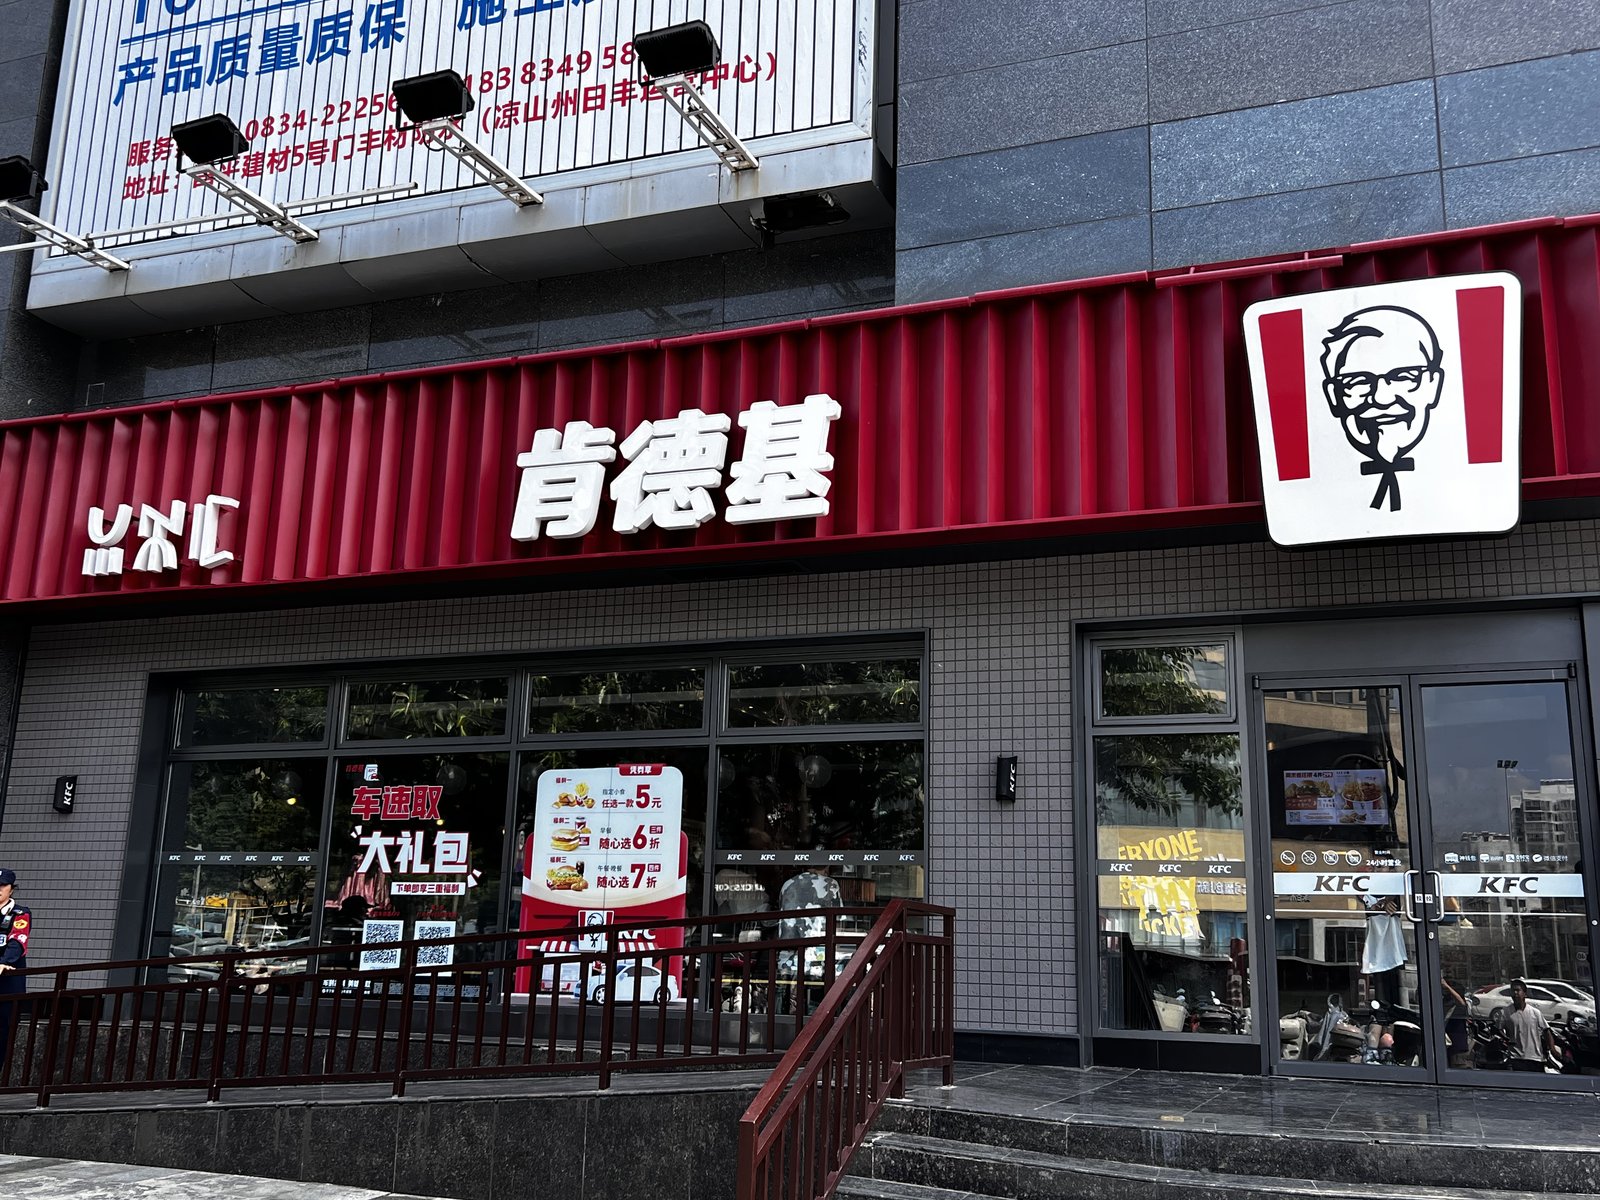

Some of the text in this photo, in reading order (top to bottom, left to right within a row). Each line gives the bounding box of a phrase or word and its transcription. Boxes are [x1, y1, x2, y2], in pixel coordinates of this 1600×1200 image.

[113, 1, 406, 106] 产品质量质保
[128, 137, 183, 167] 服务
[510, 394, 842, 541] 肯德基
[63, 781, 74, 806] KFC
[351, 785, 443, 821] 车速取
[602, 788, 626, 796] 指定小食
[356, 830, 470, 874] 大礼包
[727, 853, 915, 861] KFC KFC KFC KFC KFC KFC
[1366, 859, 1402, 867] 24小时营业
[1109, 863, 1232, 874] KFC KFC KFC
[1313, 875, 1539, 894] KFC KFC
